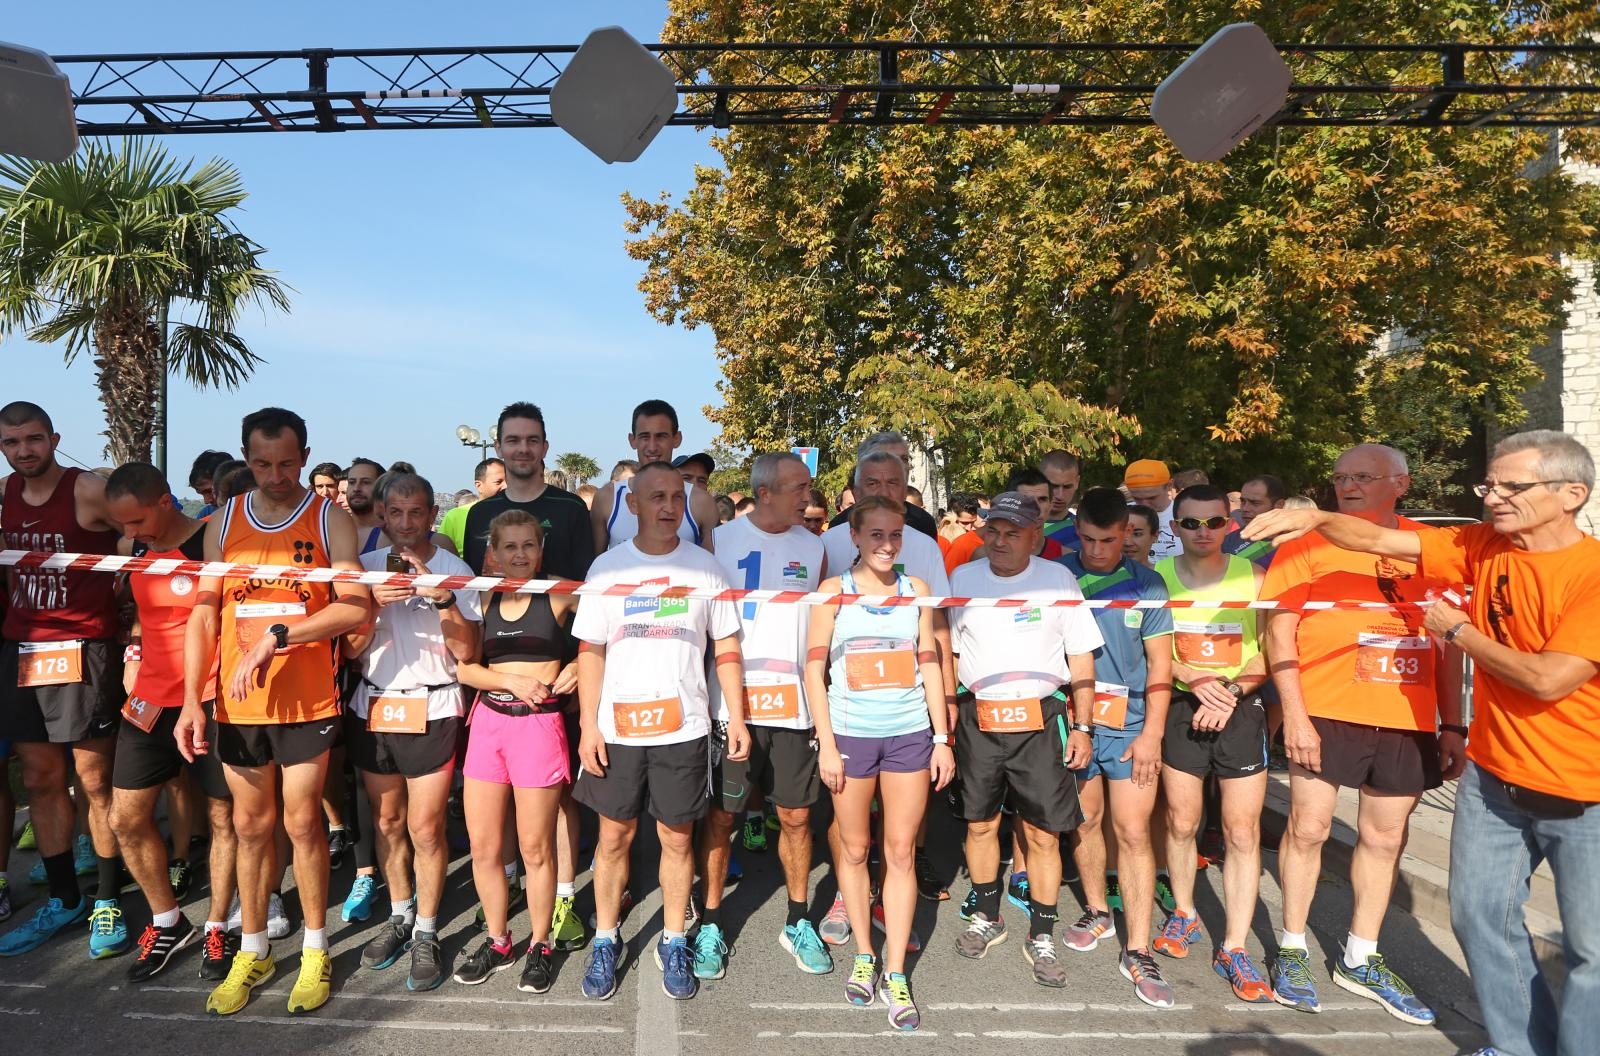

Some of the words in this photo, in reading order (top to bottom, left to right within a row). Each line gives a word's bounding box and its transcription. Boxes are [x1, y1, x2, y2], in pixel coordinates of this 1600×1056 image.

[625, 597, 659, 609] Bandić
[624, 621, 662, 632] STRANKA
[663, 619, 688, 628] RADA
[626, 627, 687, 639] SOLIDARNOSTI
[1200, 640, 1215, 657] 3
[33, 656, 68, 675] 178
[874, 659, 885, 678] 1
[1376, 655, 1419, 675] 133
[130, 696, 147, 715] 44
[749, 692, 785, 710] 124
[1099, 700, 1112, 716] 7
[383, 704, 406, 722] 94
[627, 707, 665, 728] 127
[990, 706, 1028, 723] 125
